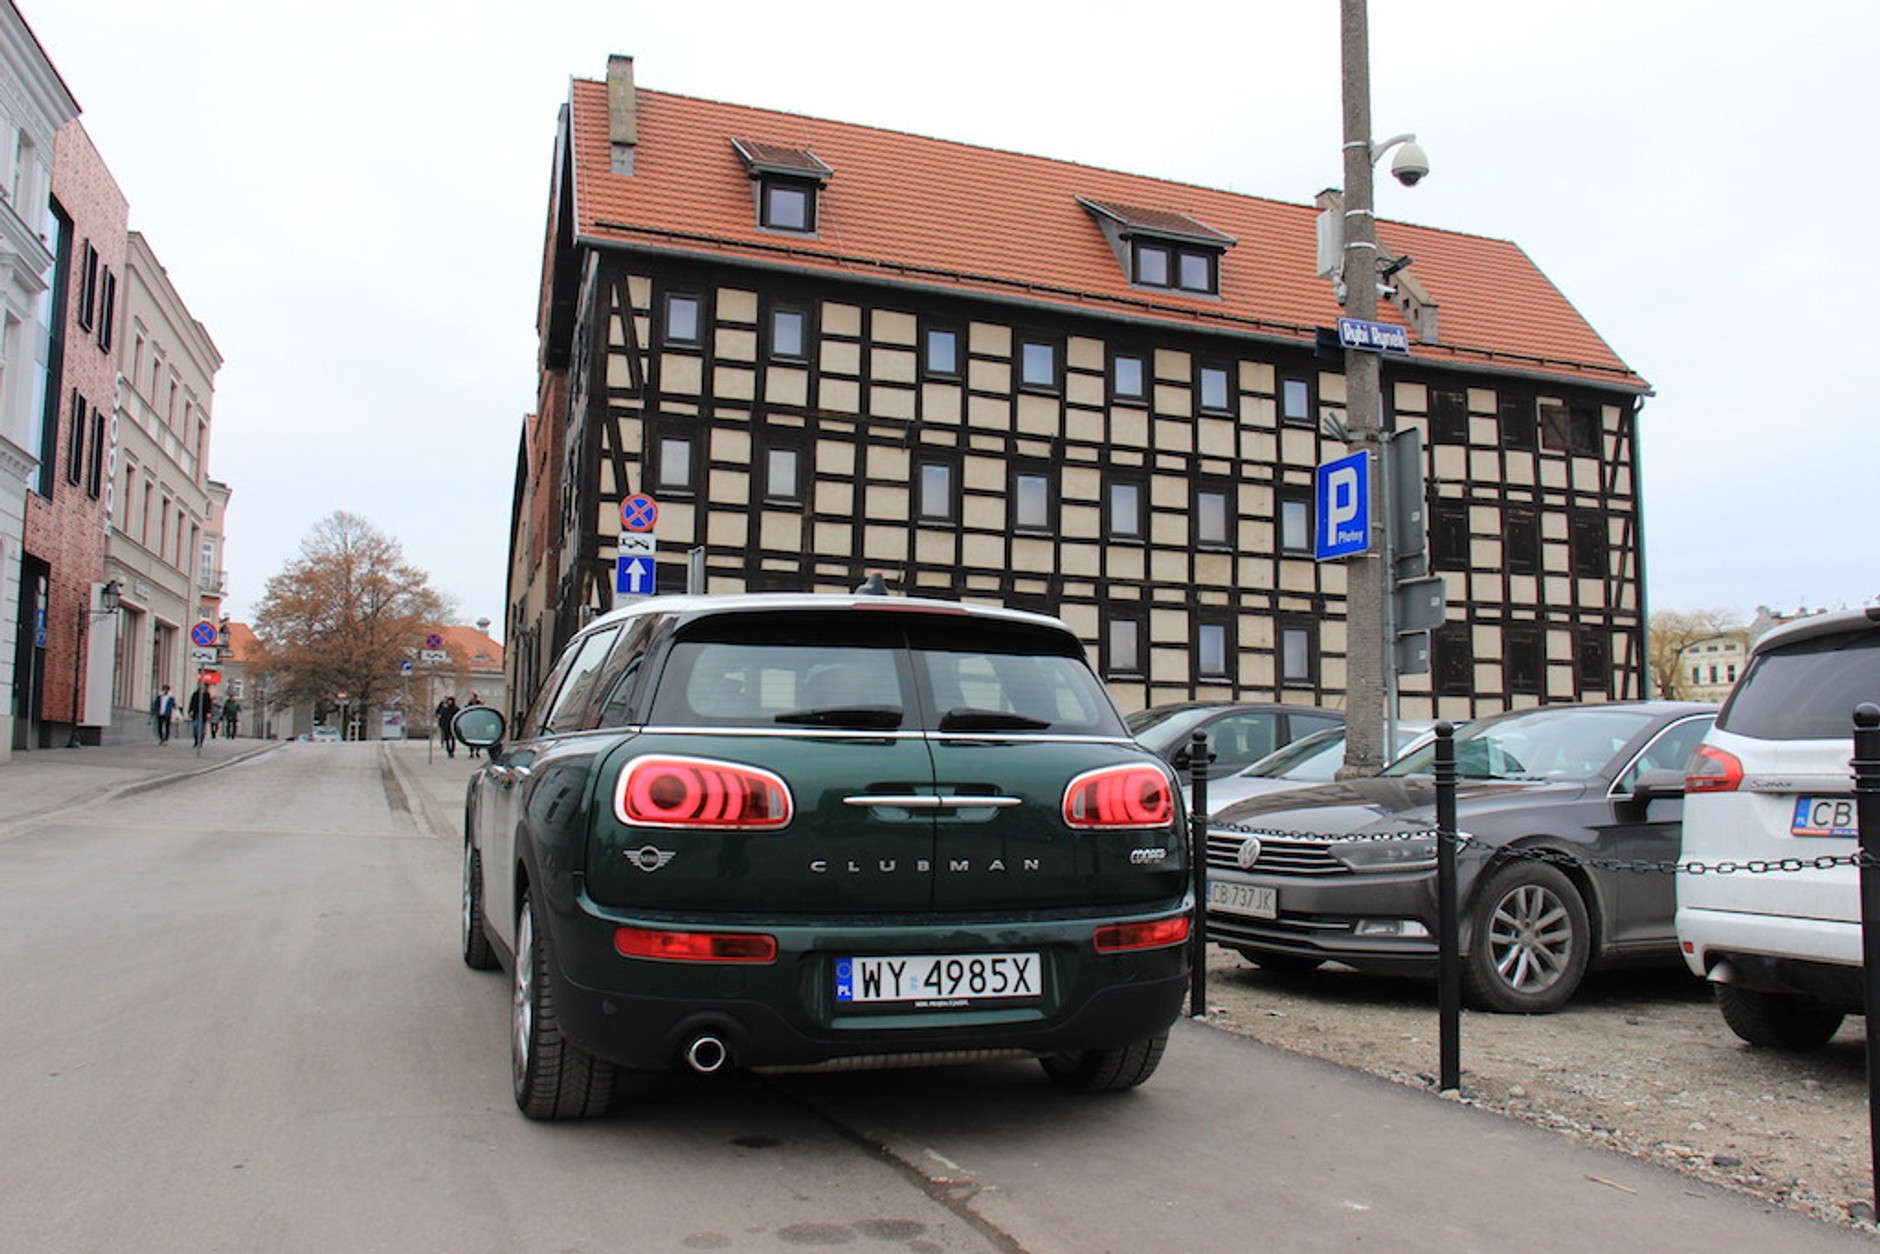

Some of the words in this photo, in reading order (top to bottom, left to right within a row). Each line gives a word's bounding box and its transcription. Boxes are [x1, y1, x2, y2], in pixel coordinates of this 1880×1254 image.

[1328, 466, 1358, 547] P
[1813, 801, 1852, 827] CB
[809, 859, 1040, 874] CLUBMAN
[1213, 884, 1228, 904] CB
[837, 985, 851, 996] PL
[862, 961, 907, 998] WY
[923, 957, 1032, 996] 4985X
